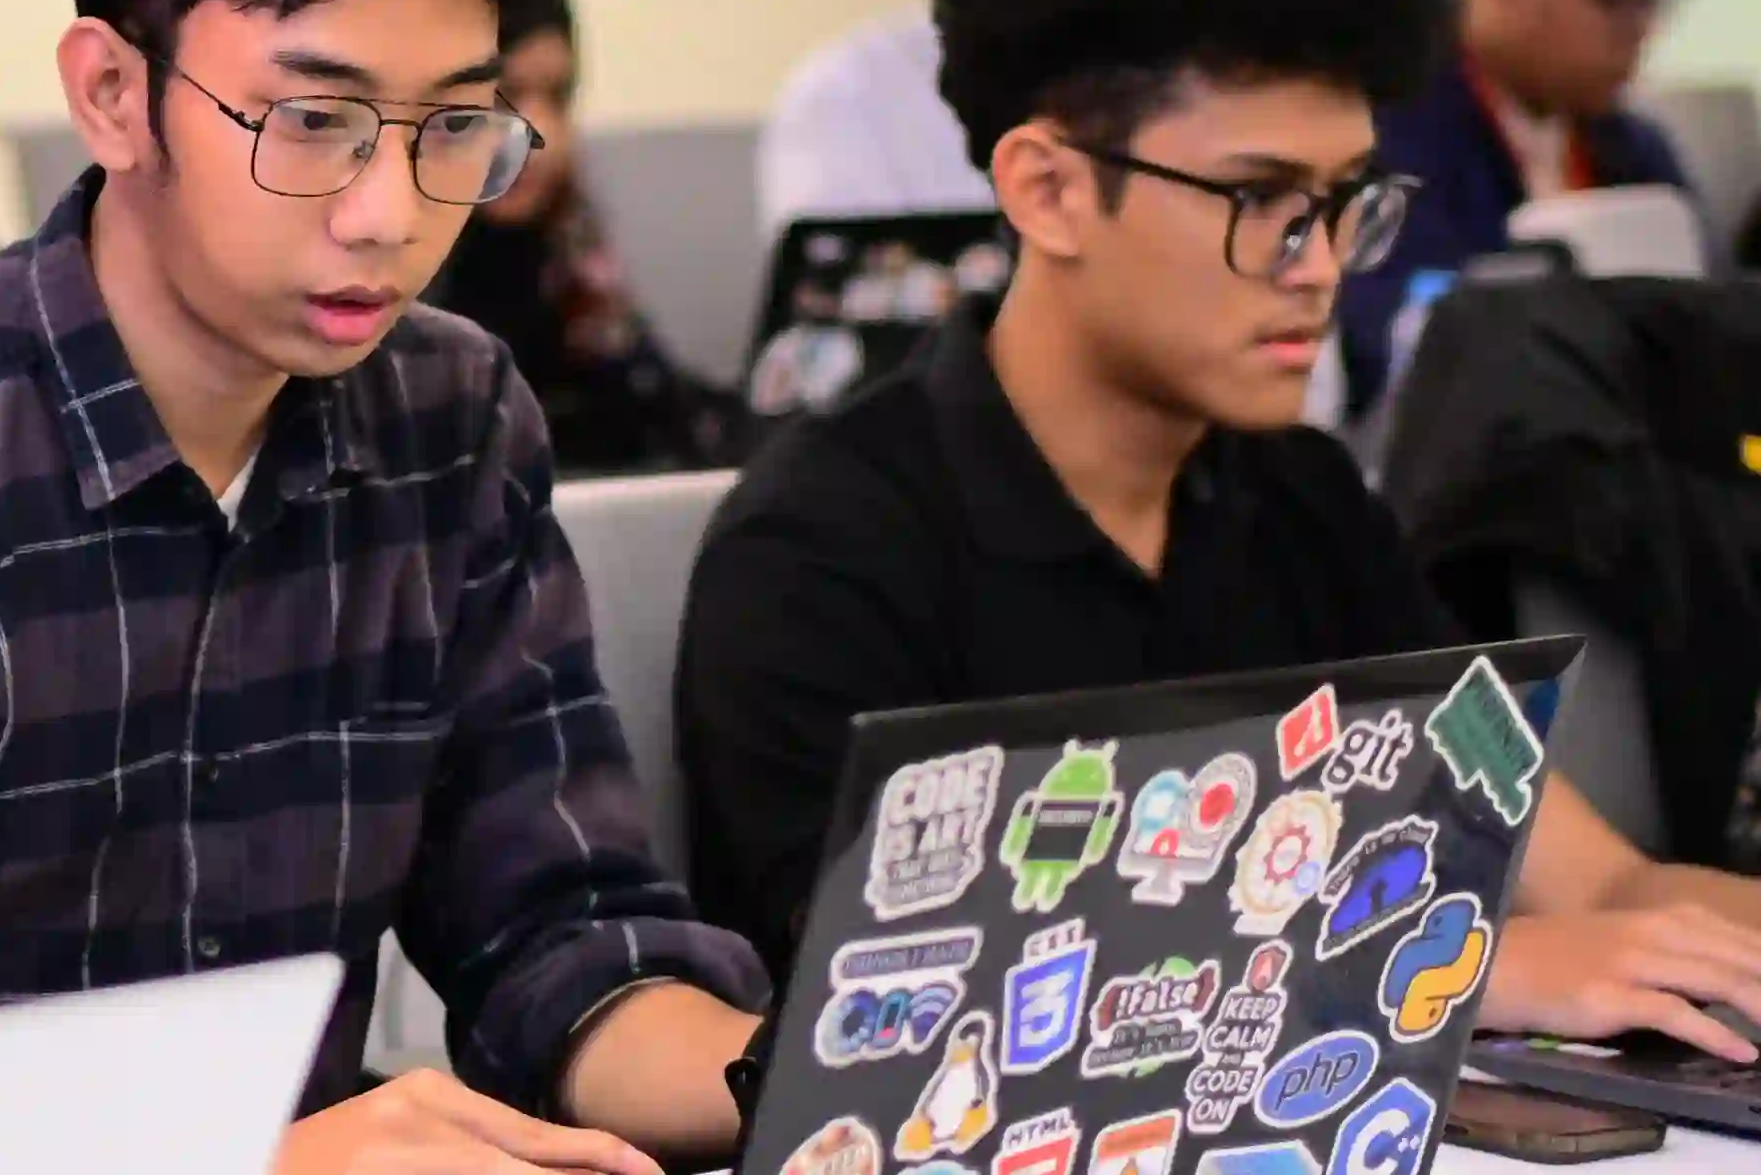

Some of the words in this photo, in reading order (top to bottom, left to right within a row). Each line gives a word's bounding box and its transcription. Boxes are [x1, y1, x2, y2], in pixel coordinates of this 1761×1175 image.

[1327, 716, 1406, 784] git
[1224, 997, 1279, 1020] KEEP
[1210, 1025, 1272, 1050] CALM
[1193, 1069, 1252, 1093] CODE
[1274, 1041, 1360, 1111] php
[1195, 1099, 1231, 1121] ON
[1007, 1112, 1073, 1147] HTML
